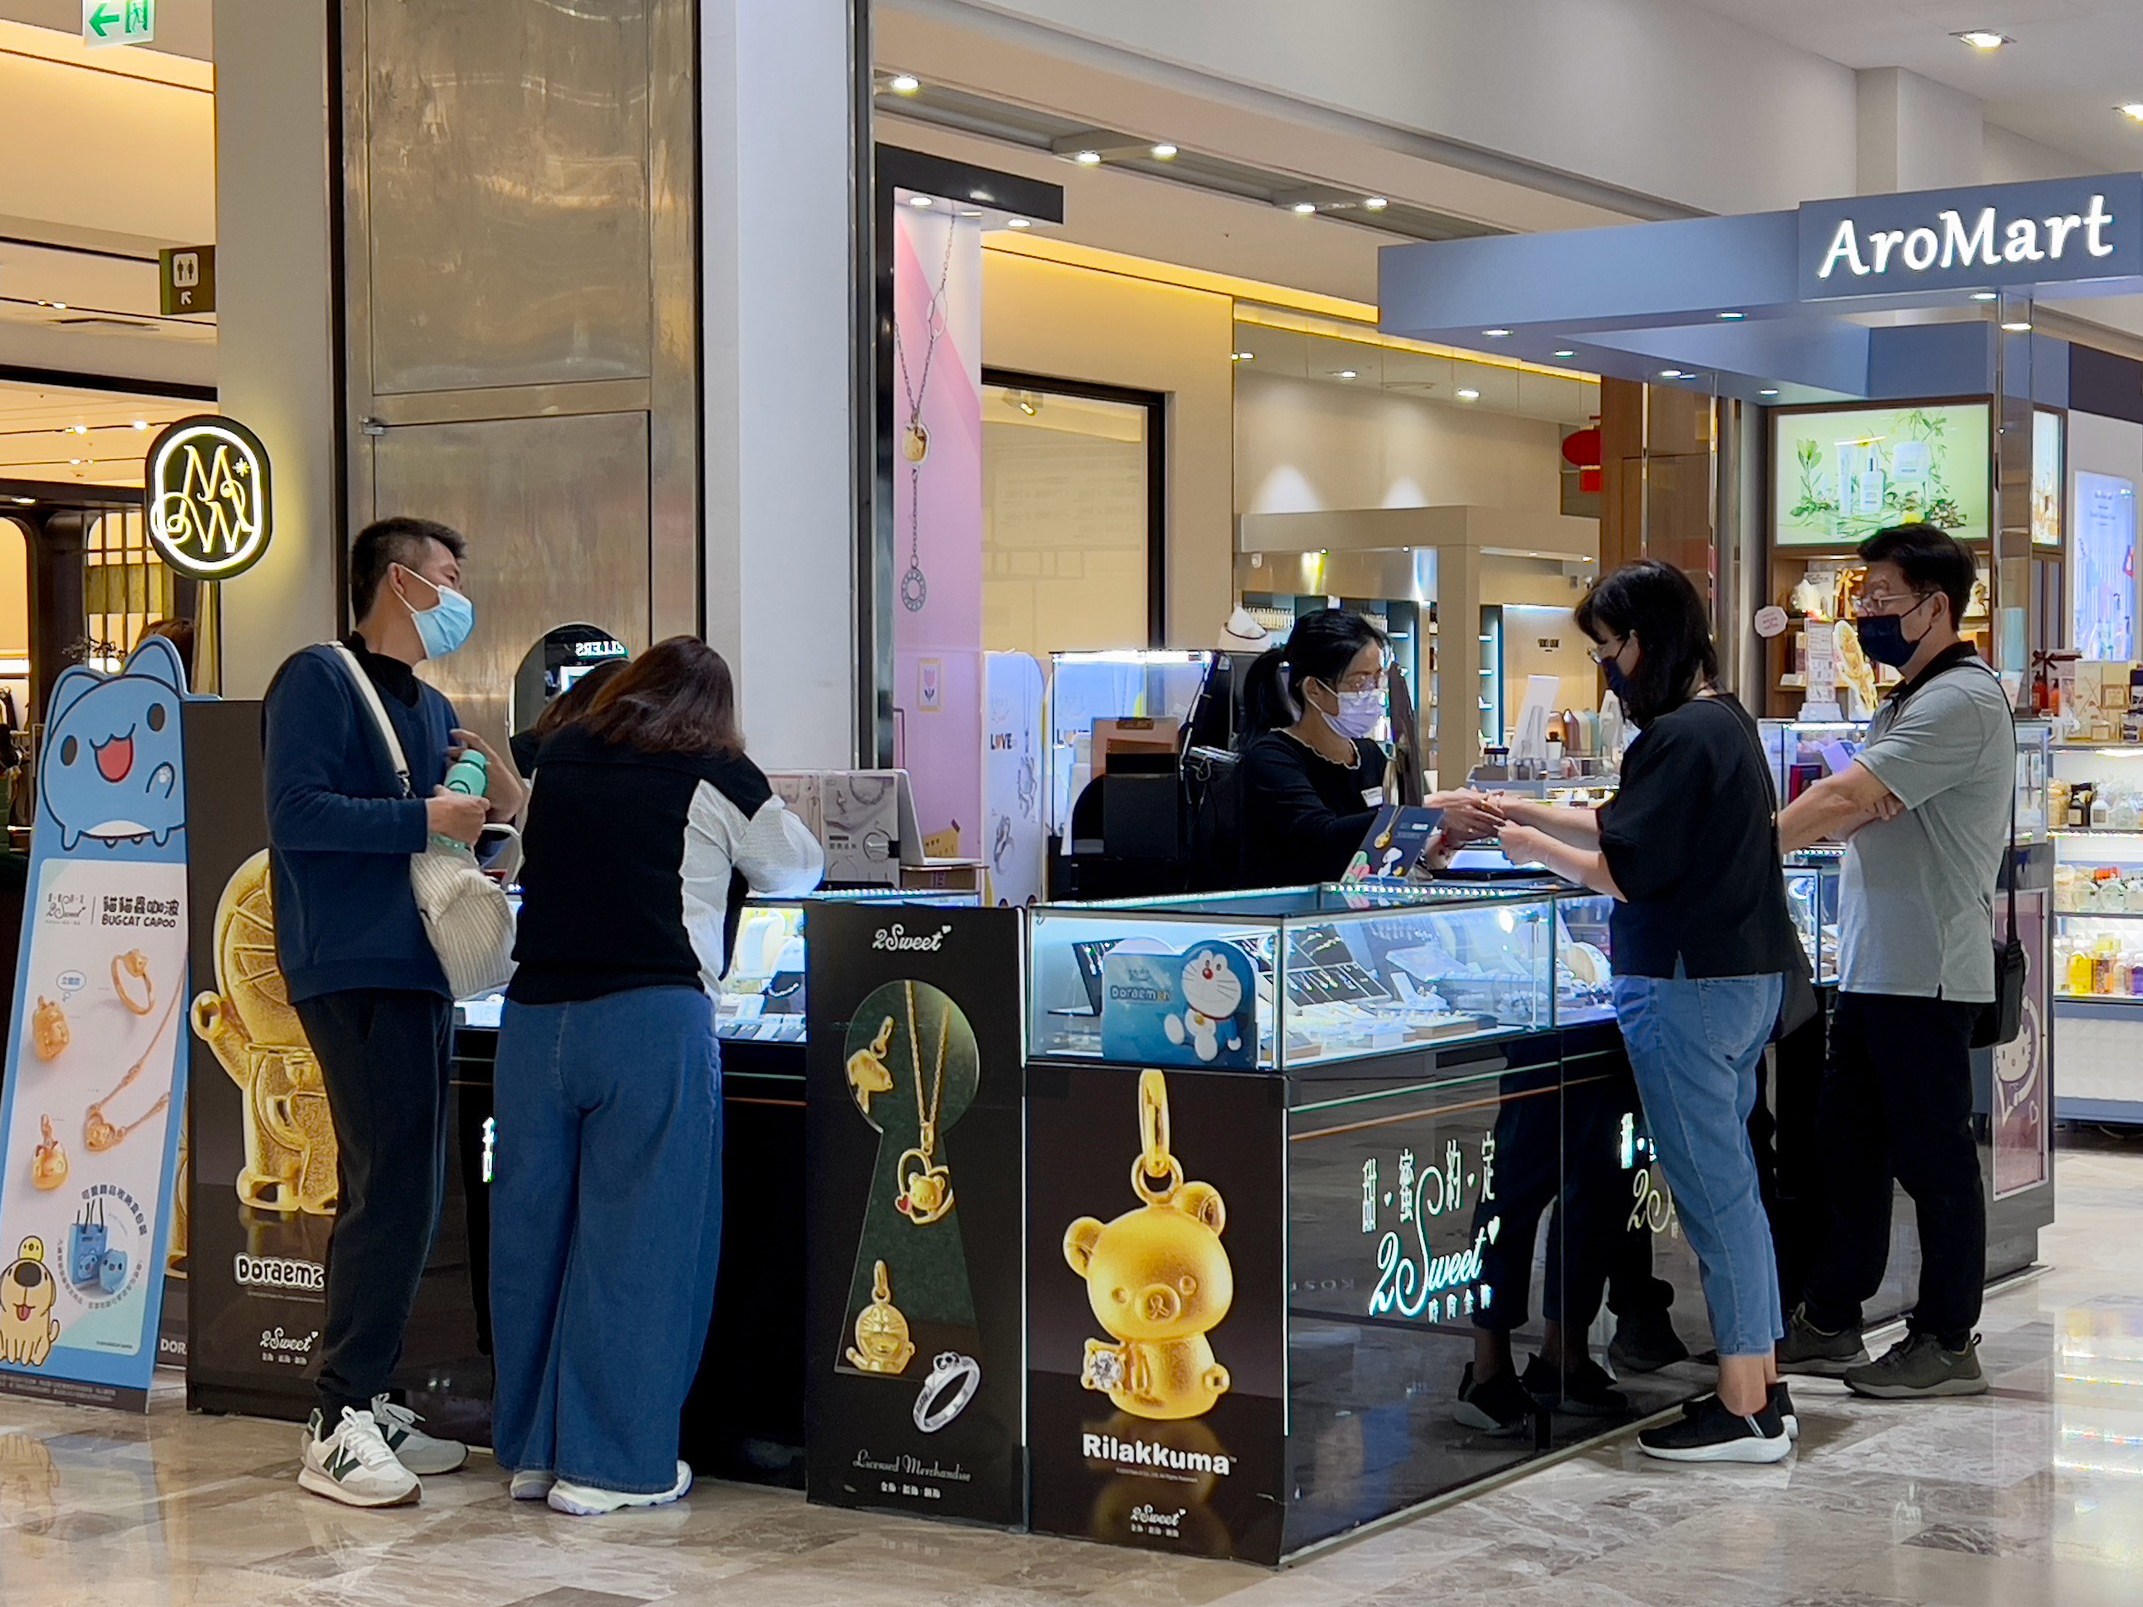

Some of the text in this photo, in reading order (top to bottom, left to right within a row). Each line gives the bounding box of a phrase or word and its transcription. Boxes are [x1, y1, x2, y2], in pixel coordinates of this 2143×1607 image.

[1817, 194, 2114, 279] AroMart
[102, 914, 177, 928] BUGCAT CAPOO
[872, 923, 944, 951] 2Sweet
[1369, 1166, 1488, 1317] 2Sweet
[260, 1327, 313, 1353] 2Sweet
[1082, 1433, 1230, 1476] Rilakkuma
